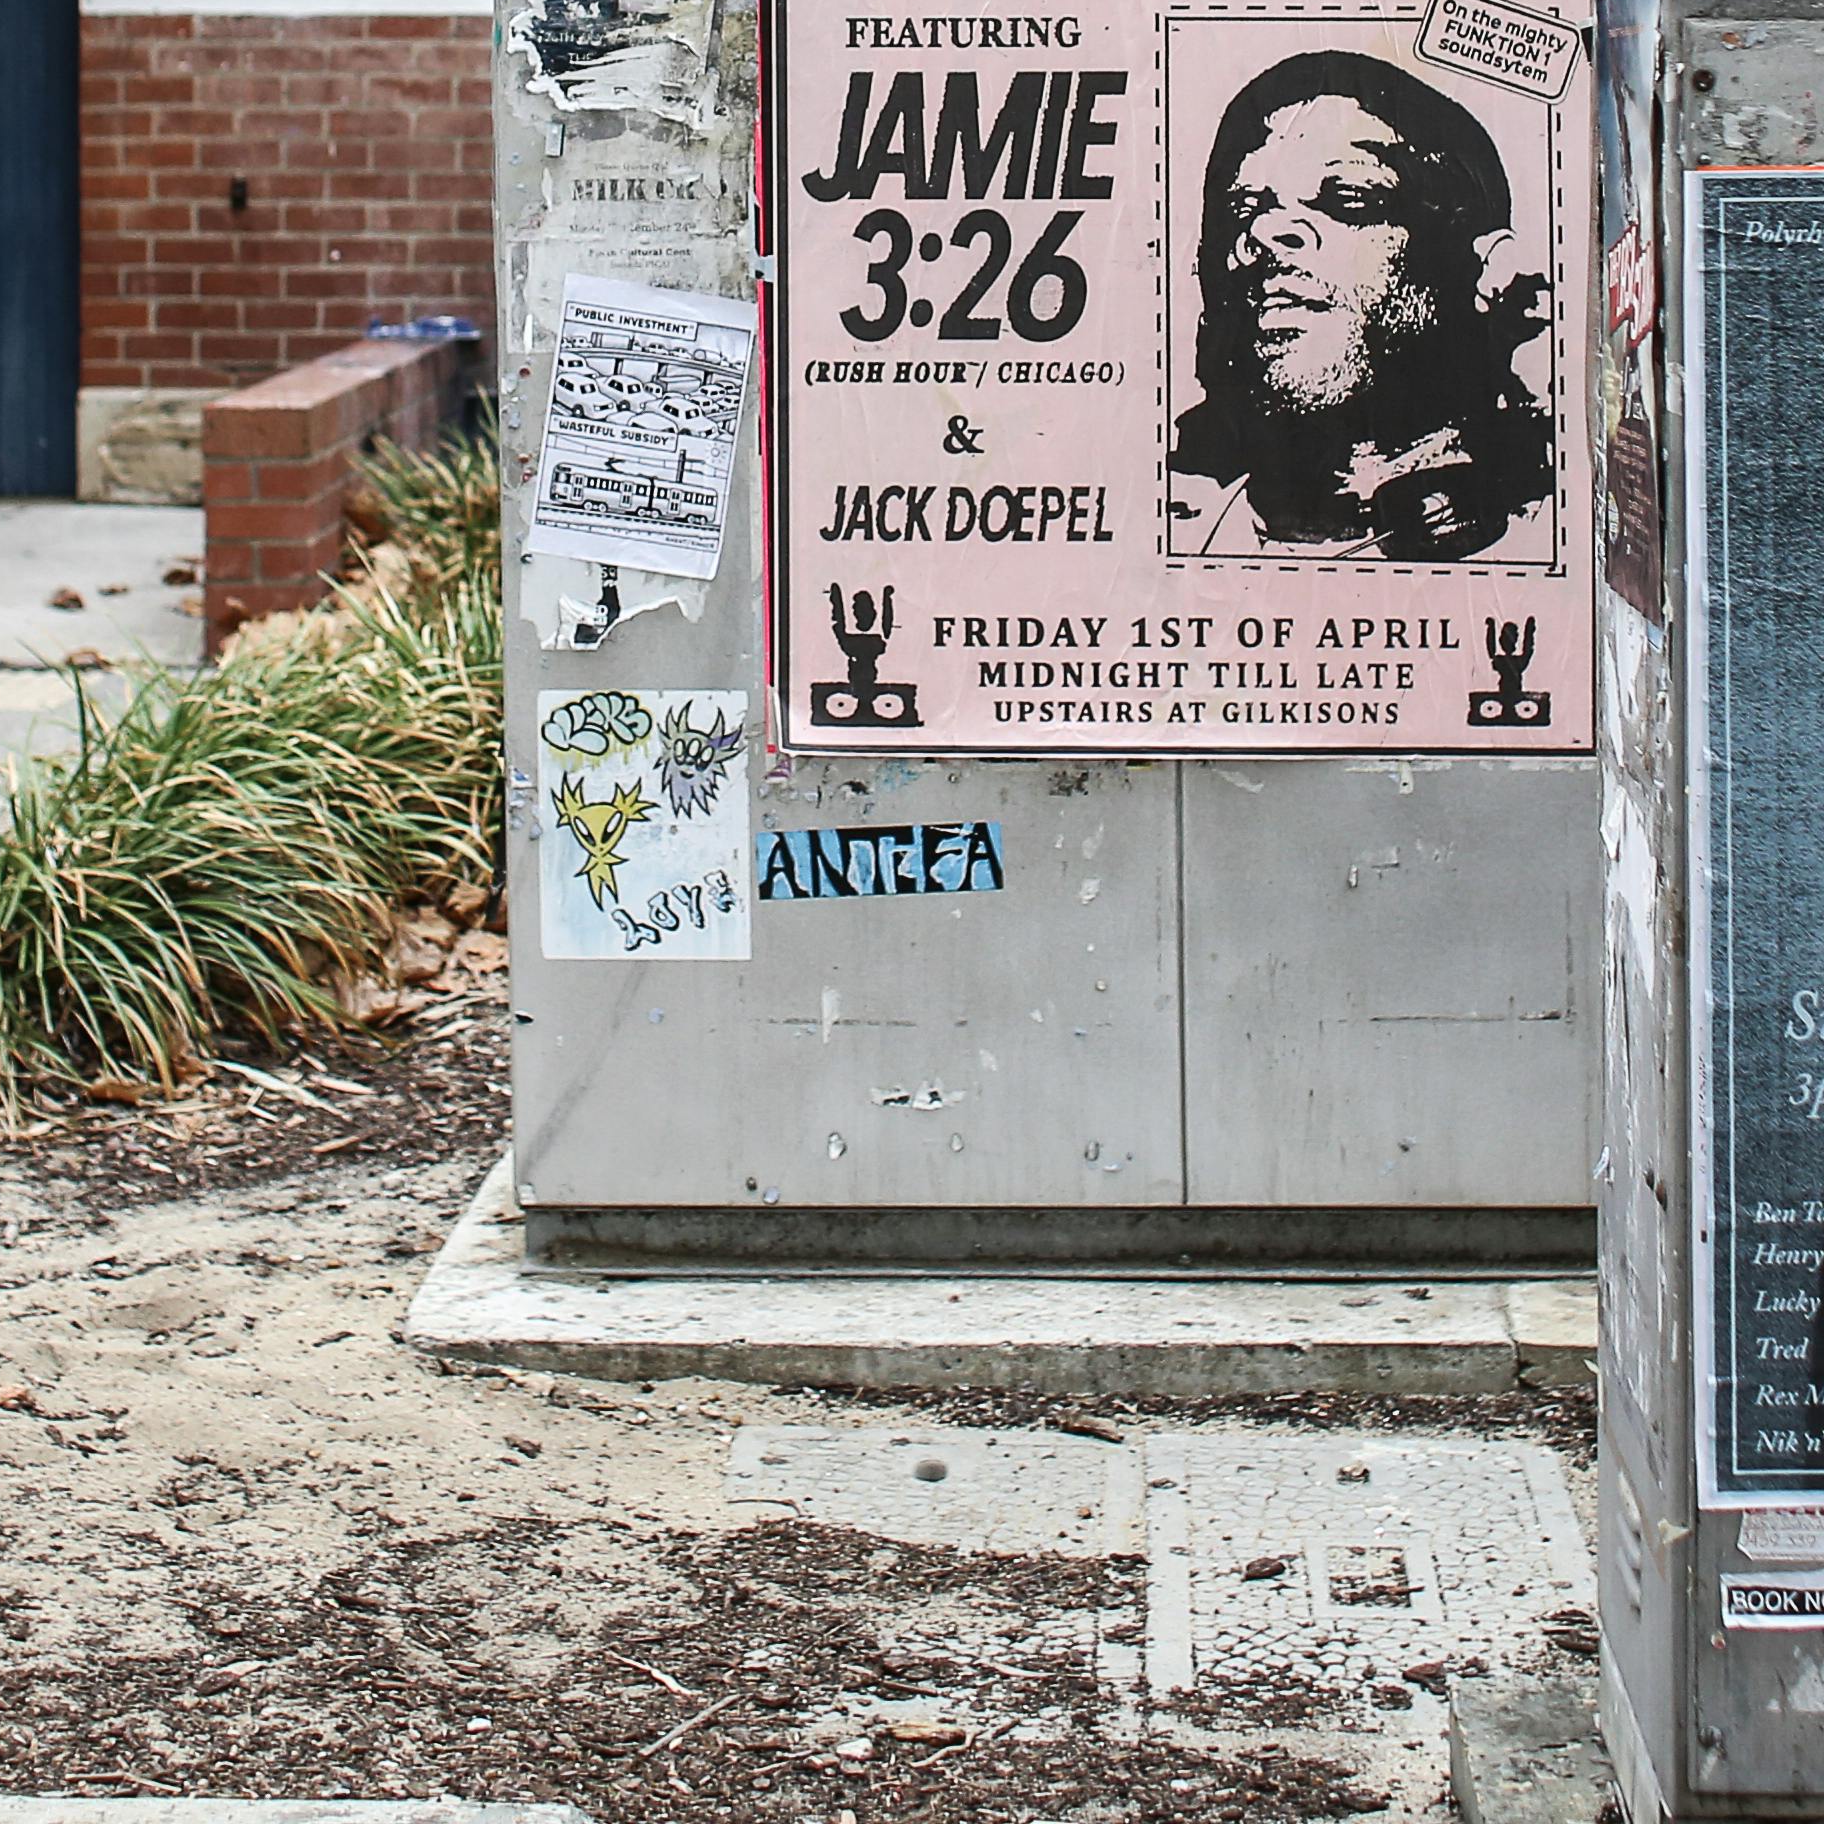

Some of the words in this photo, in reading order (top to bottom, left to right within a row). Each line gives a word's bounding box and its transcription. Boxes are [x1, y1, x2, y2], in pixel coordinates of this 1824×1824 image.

[845, 16, 1082, 48] FEATURING
[1442, 0, 1468, 19] On
[1471, 6, 1502, 30] the
[1505, 20, 1568, 53] mighty
[1444, 19, 1541, 63] FUNKTION
[1543, 52, 1552, 66] 1
[1438, 38, 1548, 83] soundsytem
[801, 70, 1129, 203] JAMIE
[839, 208, 1088, 342] 3:26
[805, 360, 884, 386] (RUSH
[892, 362, 969, 384] HOUR
[997, 361, 1127, 386] CHICAGO)
[942, 414, 985, 454] &
[819, 484, 937, 542] JACK
[945, 484, 1114, 542] DOEPEL
[933, 616, 1108, 648] FRIDAY
[1130, 616, 1213, 648] 1ST
[1237, 617, 1295, 649] OF
[1315, 617, 1461, 649] APRIL
[978, 661, 1189, 688] MIDNIGHT
[1208, 662, 1298, 689] TILL
[1317, 662, 1415, 689] LATE
[993, 701, 1153, 723] UPSTAIRS
[1167, 701, 1207, 723] AT
[1222, 701, 1400, 724] GILKISONS
[1753, 1201, 1797, 1224] Ben
[1752, 1242, 1824, 1272] Henry
[1753, 1289, 1821, 1320] Lucky
[1755, 1337, 1810, 1360] Tred
[1754, 1383, 1800, 1407] Rex
[1754, 1429, 1799, 1453] Nik
[1731, 1588, 1798, 1613] BOOK
